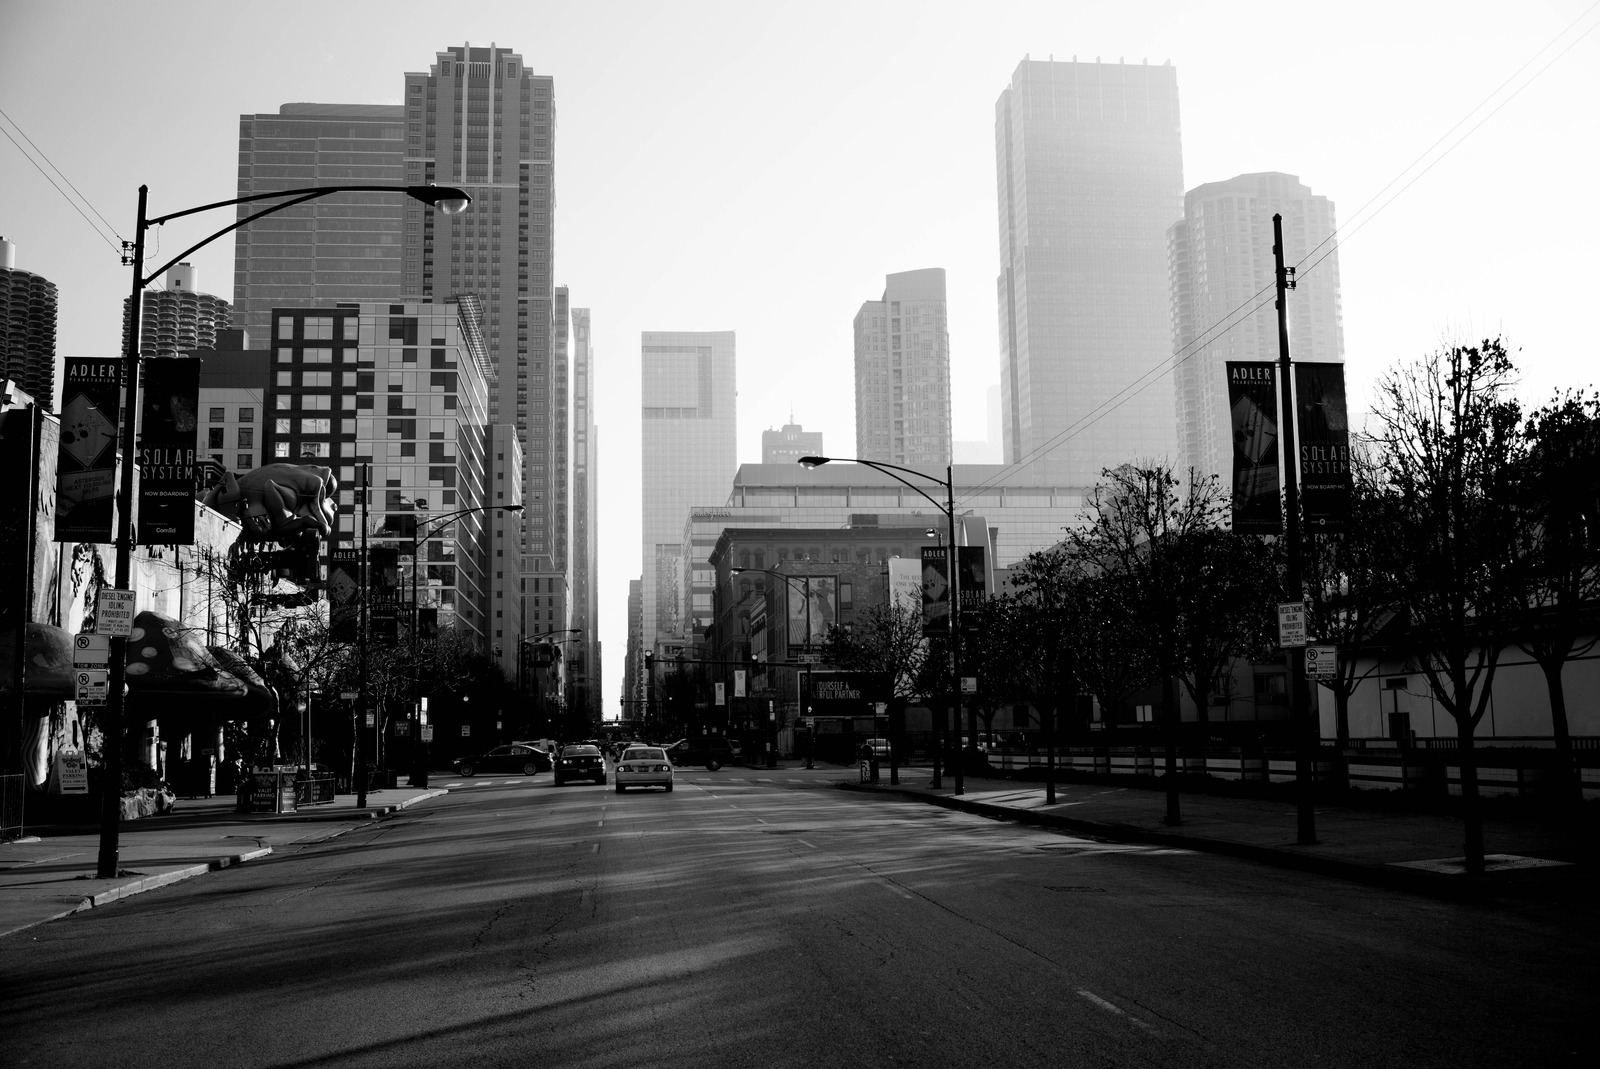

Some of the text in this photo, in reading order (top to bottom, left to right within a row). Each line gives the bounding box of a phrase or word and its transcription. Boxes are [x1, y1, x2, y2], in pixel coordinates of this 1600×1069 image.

[70, 364, 116, 378] ADLER
[1233, 368, 1271, 379] ADLER
[143, 449, 194, 466] SOLAR
[1302, 446, 1347, 460] SOLAR
[1303, 462, 1347, 474] SYSTEM
[142, 466, 193, 480] SYSTEM
[74, 476, 104, 484] ASTEROIDS
[102, 592, 133, 601] DIESEL ENGINE
[961, 590, 985, 598] SOLAR
[102, 610, 129, 618] PROHIBITED
[1282, 622, 1302, 630] PROHIBITED
[845, 682, 850, 690] A
[834, 690, 861, 699] PARTNER
